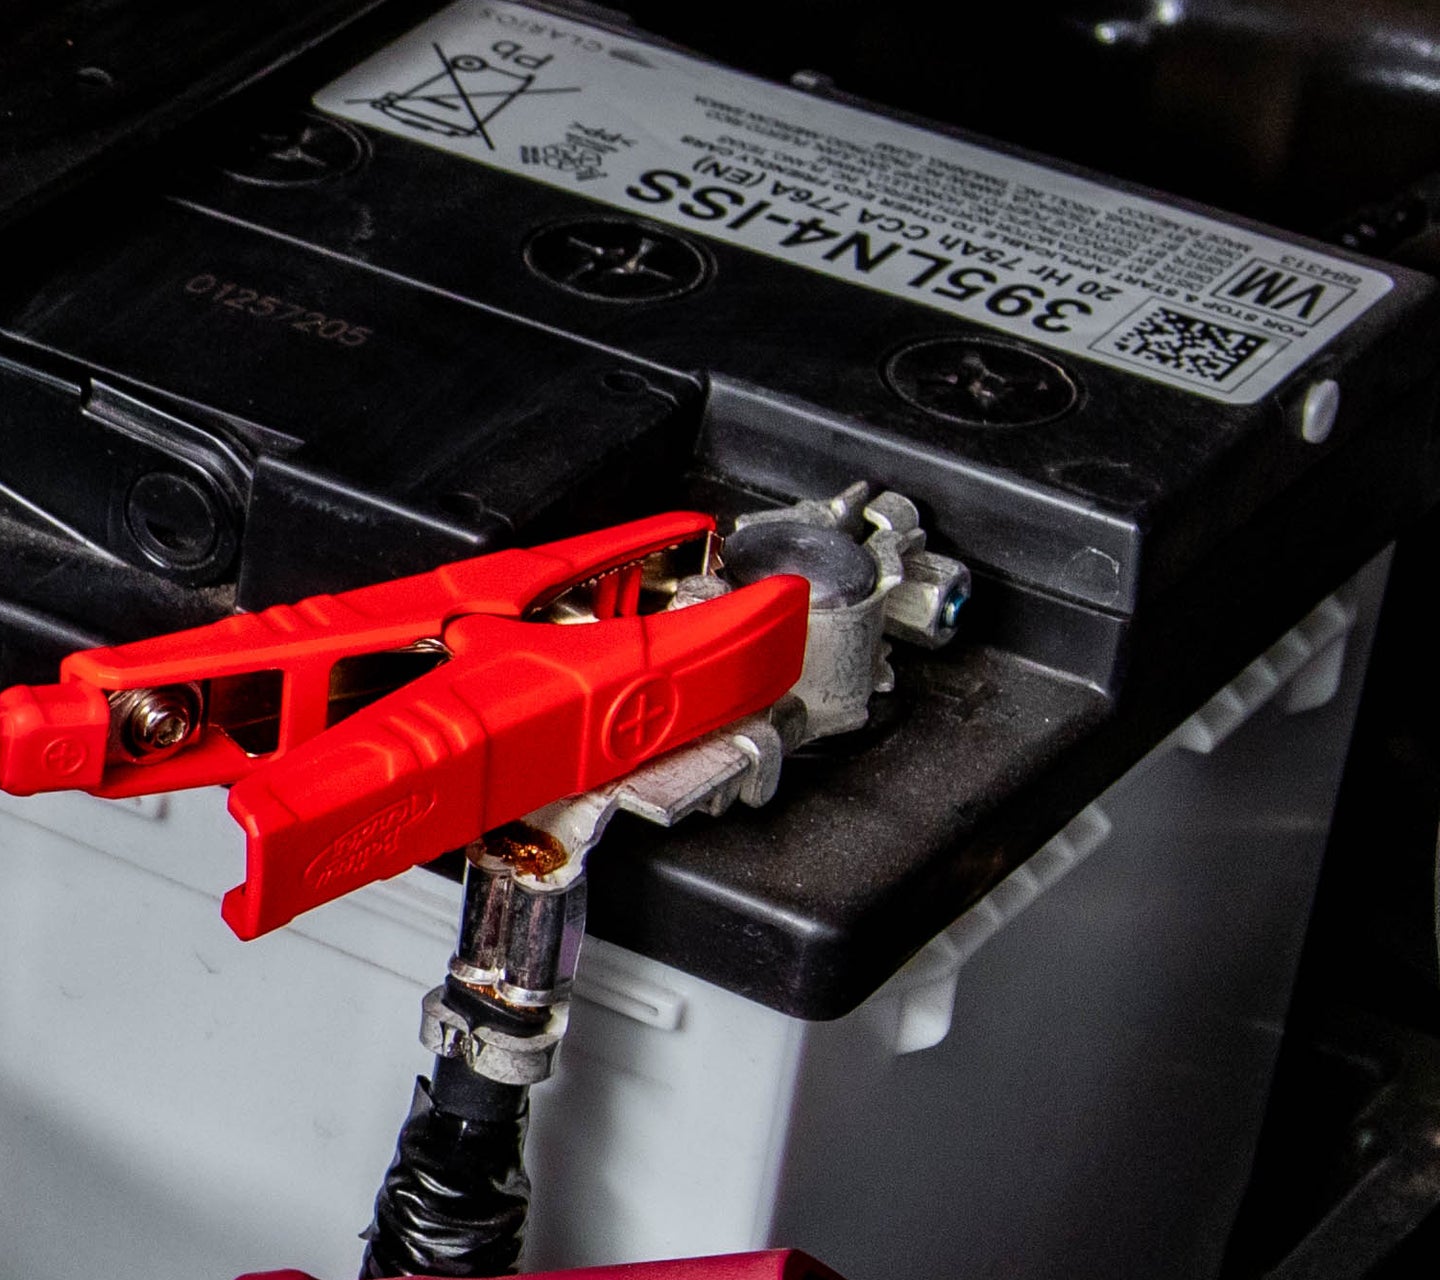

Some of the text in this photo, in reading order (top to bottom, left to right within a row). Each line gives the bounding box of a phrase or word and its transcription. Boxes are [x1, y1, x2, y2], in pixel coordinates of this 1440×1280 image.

[475, 7, 608, 53] CLARIOS
[491, 39, 555, 70] Pb
[677, 134, 736, 156] CARS
[737, 153, 831, 187] FRIENDLY
[830, 183, 876, 201] ECO
[876, 197, 949, 224] OTHER
[687, 154, 1122, 301] 20 Hr 75Ah CCA 776A (EN)
[948, 220, 978, 233] TO
[626, 169, 1092, 335] 395LN4-ISS
[982, 231, 1110, 275] APPLICABLE
[1111, 272, 1180, 297] START
[1229, 264, 1330, 319] VM
[1199, 300, 1258, 322] STOP
[1259, 319, 1307, 338] FOR
